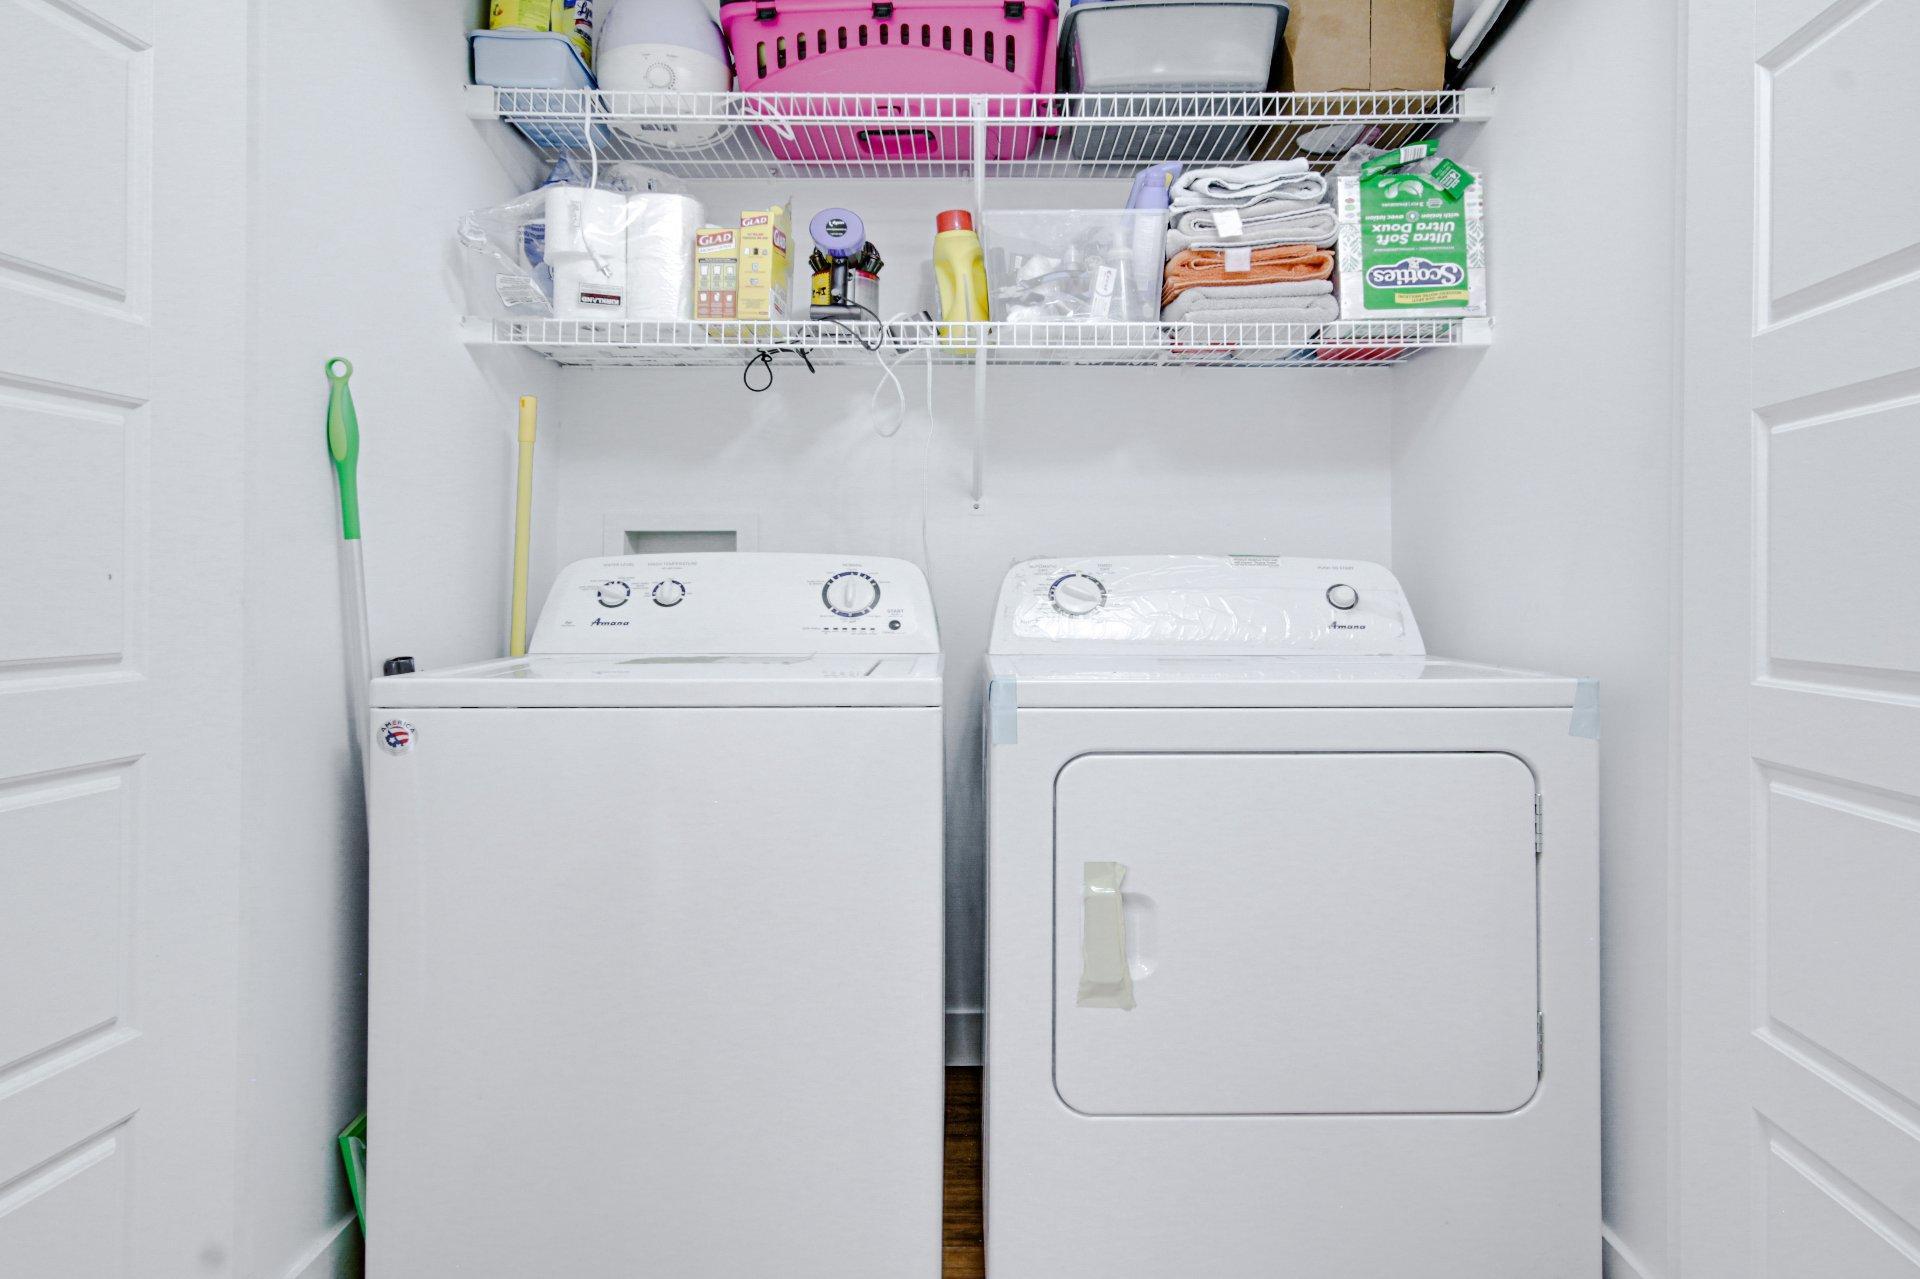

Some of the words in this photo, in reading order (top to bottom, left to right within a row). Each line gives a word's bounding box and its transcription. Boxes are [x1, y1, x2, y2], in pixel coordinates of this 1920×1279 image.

[742, 216, 768, 227] GLAD
[1417, 221, 1455, 232] Ultra
[1372, 223, 1412, 233] Doux
[699, 232, 732, 246] GLAD
[1376, 233, 1409, 245] Soft
[1413, 233, 1452, 243] Ultra
[1373, 264, 1458, 285] Scotties
[581, 296, 619, 305] KIRKLAND
[590, 617, 630, 626] Amana
[1329, 620, 1366, 630] Amana
[381, 720, 415, 733] AMERICA
